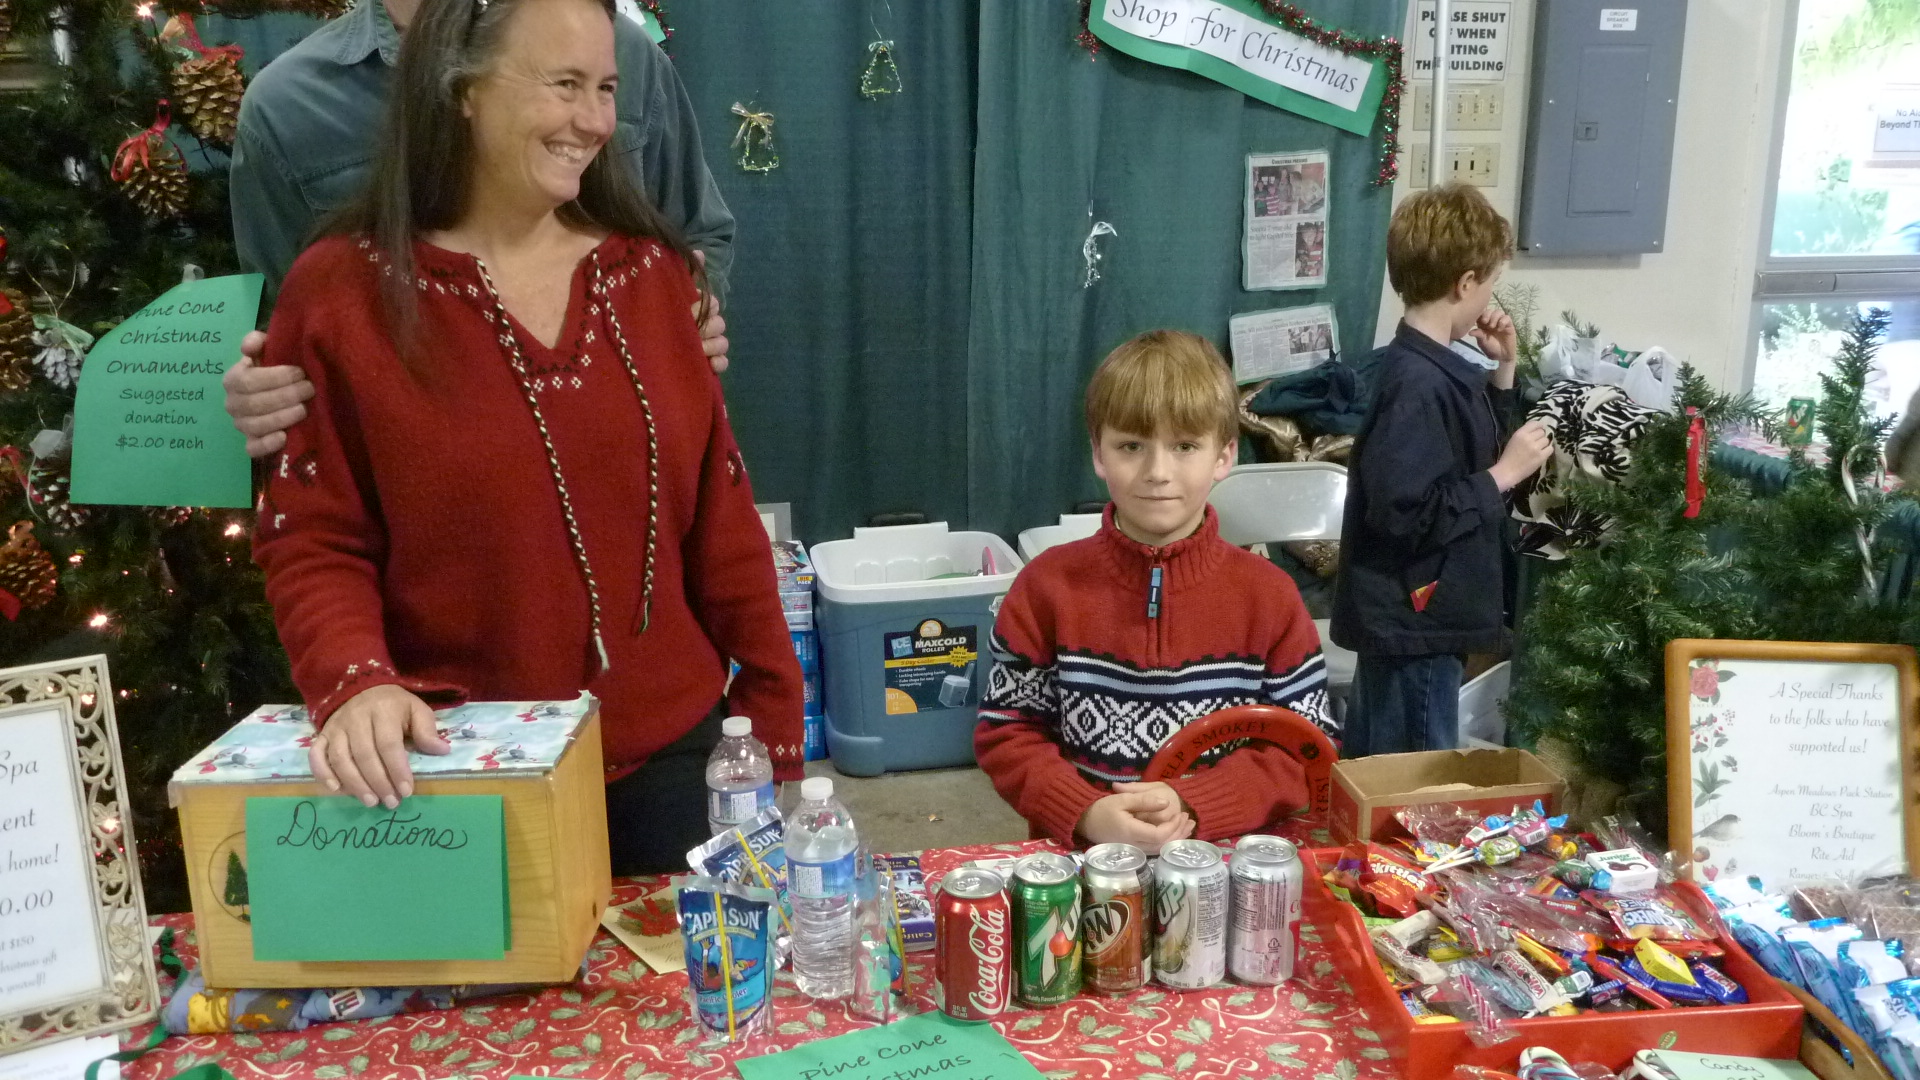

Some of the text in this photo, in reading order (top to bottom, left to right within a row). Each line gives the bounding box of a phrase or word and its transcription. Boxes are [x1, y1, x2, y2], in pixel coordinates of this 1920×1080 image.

[1421, 11, 1505, 23] PLSE SHUT
[1457, 28, 1496, 39] WHEN
[1190, 7, 1236, 46] for
[1241, 31, 1358, 93] Christmas
[1451, 45, 1488, 55] ITING
[1449, 61, 1503, 71] UILDING
[1880, 120, 1911, 130] Beyond
[178, 301, 225, 316] Cone
[120, 327, 222, 345] Christmas
[106, 359, 225, 376] Ornaments
[119, 387, 204, 404] Suggested
[124, 410, 198, 425] donation
[115, 435, 204, 452] $2.00 each
[915, 637, 966, 649] MAXCOLD
[1788, 682, 1835, 702] Special
[1836, 683, 1884, 701] Thanks
[1769, 709, 1890, 729] to the folks who have
[1192, 721, 1272, 750] SMOKEY
[1788, 736, 1867, 756] supported us!
[1863, 786, 1895, 799] Station
[1809, 803, 1853, 820] BC Spa
[277, 800, 468, 850] Donations
[1788, 824, 1876, 842] Bloom's Boutique
[8, 843, 60, 872] home!
[1599, 853, 1630, 862] Junior
[1810, 846, 1855, 861] Rite Aid
[968, 903, 1005, 1015] Coca-Cola
[877, 1034, 948, 1060] Cone
[1699, 1057, 1766, 1079] Candy
